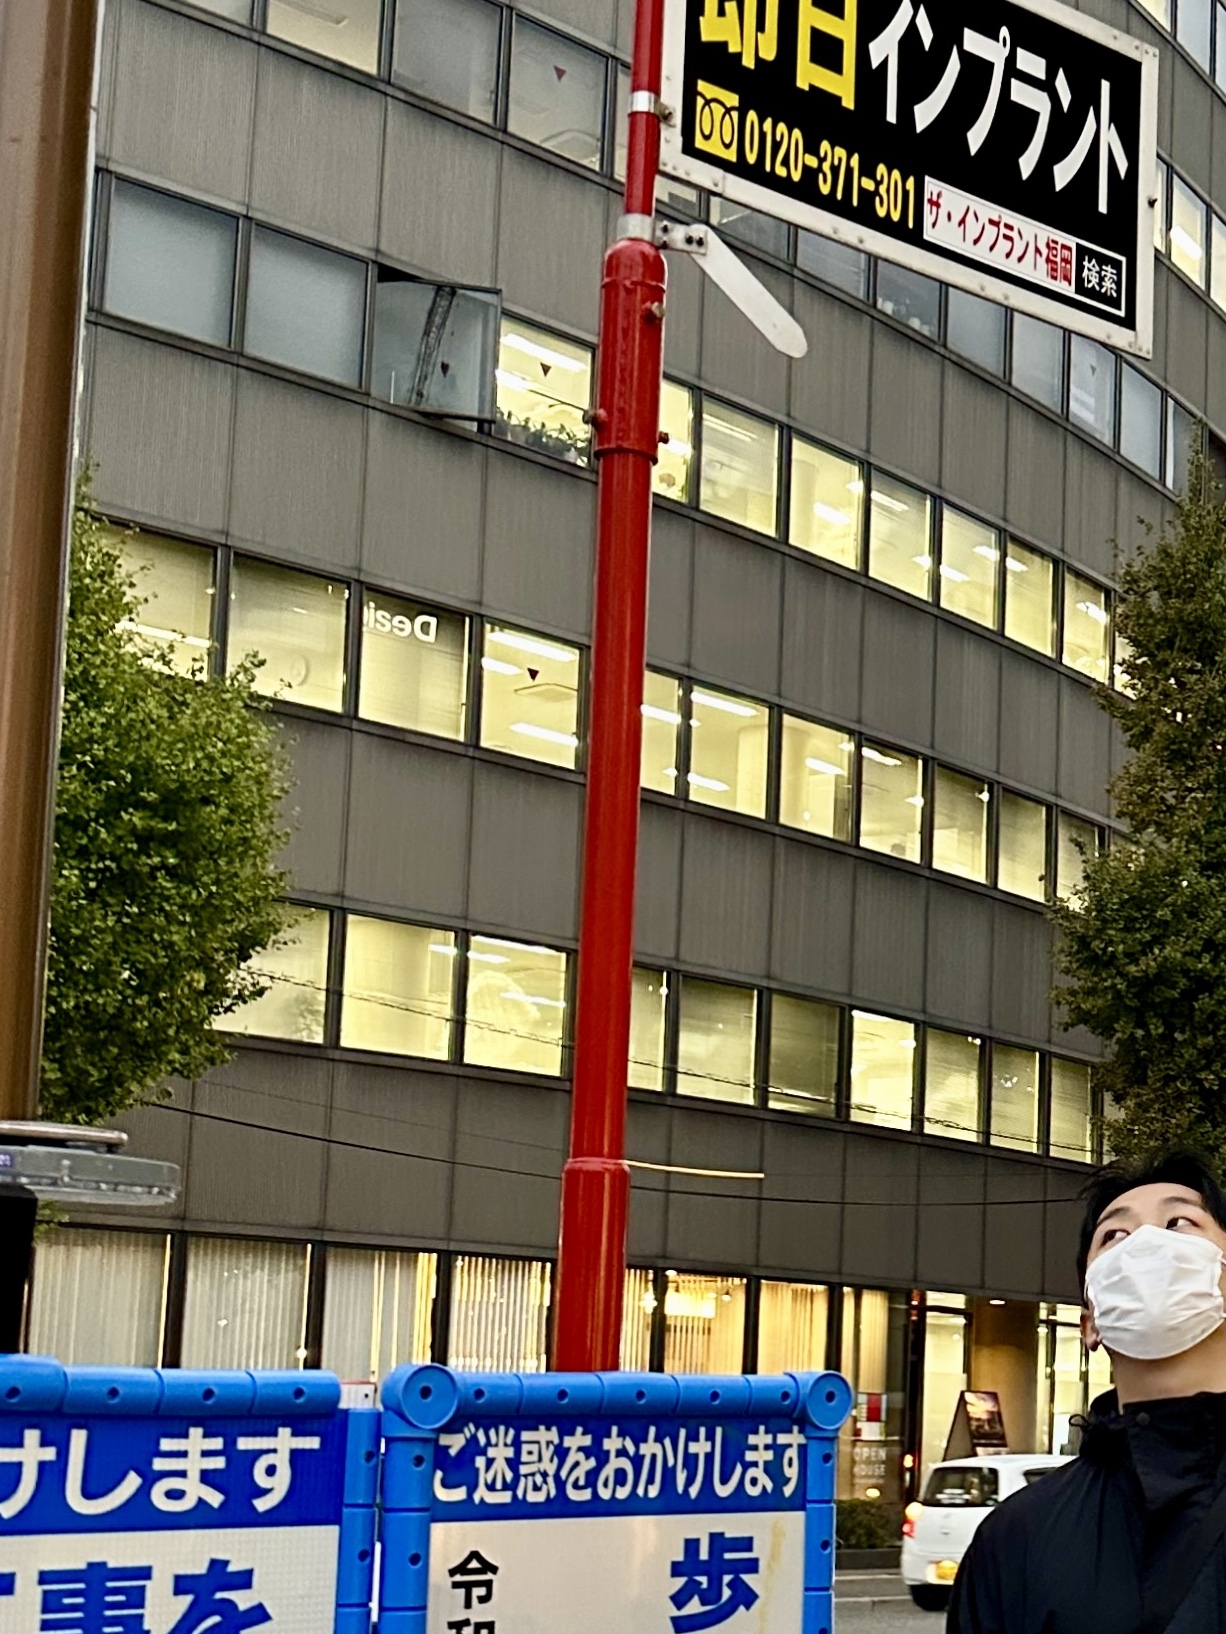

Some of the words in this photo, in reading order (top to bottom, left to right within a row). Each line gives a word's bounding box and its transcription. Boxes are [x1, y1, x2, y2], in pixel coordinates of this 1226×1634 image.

[745, 110, 915, 229] 0120-371-301
[927, 190, 1073, 286] ザ・インプラント福岡
[1082, 256, 1117, 297] 検索
[433, 1422, 806, 1504] ご迷惑をおかけします
